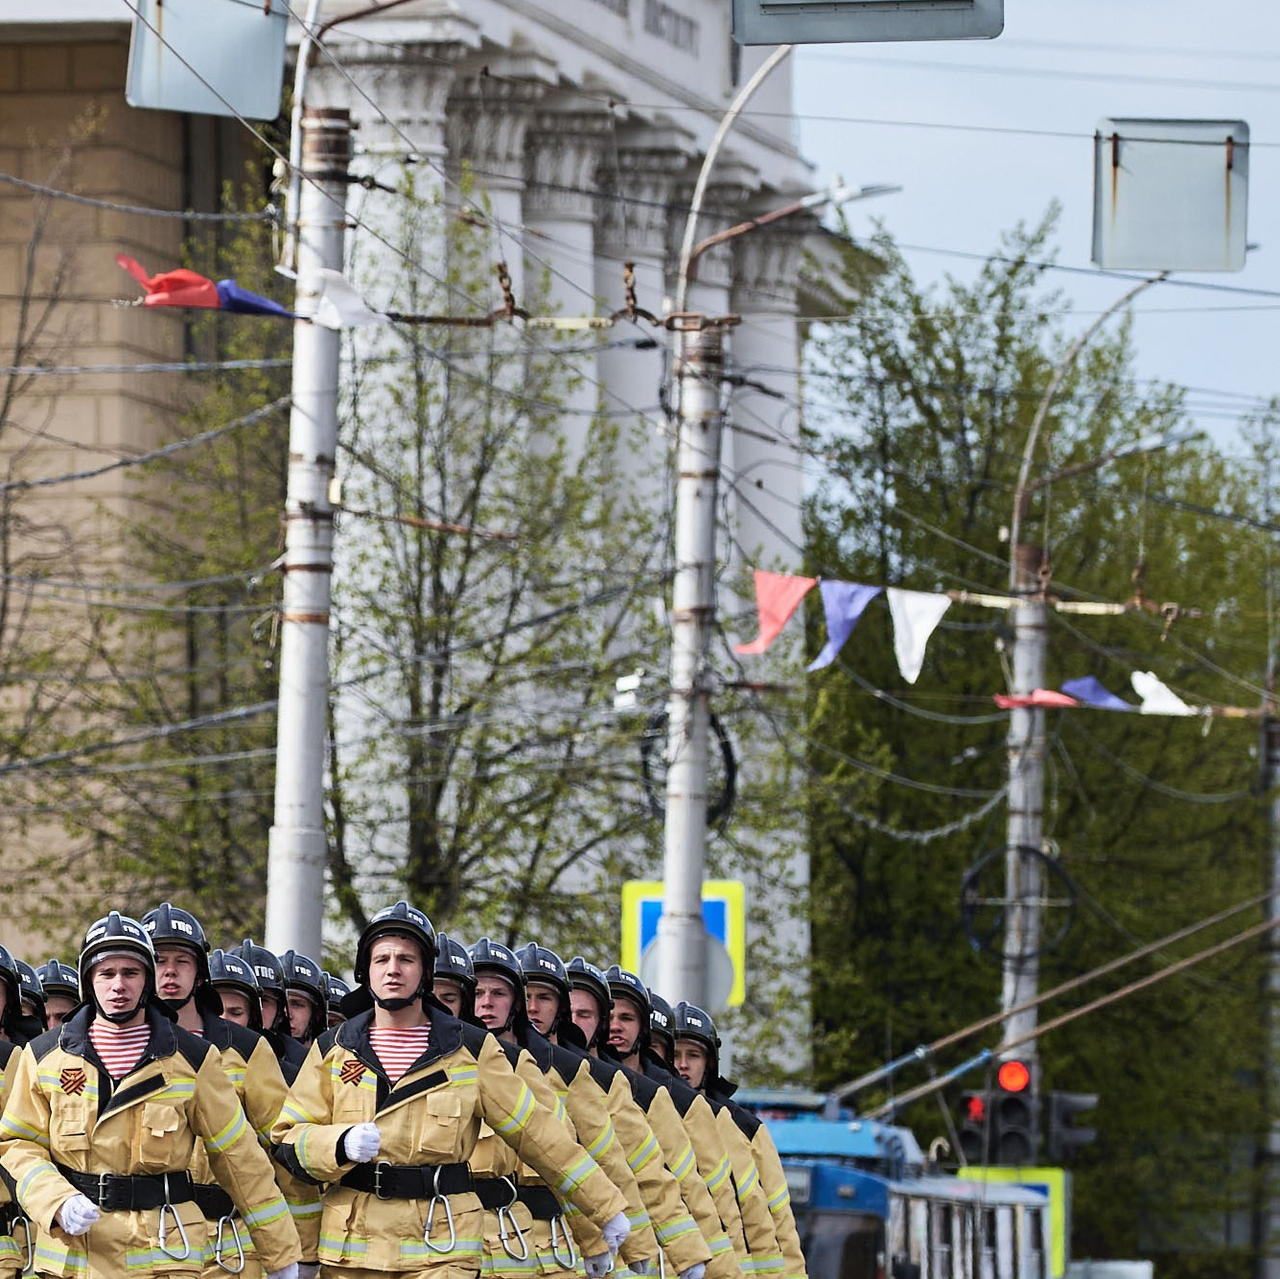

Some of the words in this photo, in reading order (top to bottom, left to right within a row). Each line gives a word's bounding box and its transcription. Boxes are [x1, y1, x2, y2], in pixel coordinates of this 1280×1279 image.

[122, 925, 140, 936] ГПС
[171, 920, 193, 935] ГПС
[490, 949, 508, 961] ГПС
[225, 964, 243, 975] ГПС
[294, 965, 312, 977] ГПС
[539, 959, 556, 972] ГПС
[254, 965, 275, 980] ГПС
